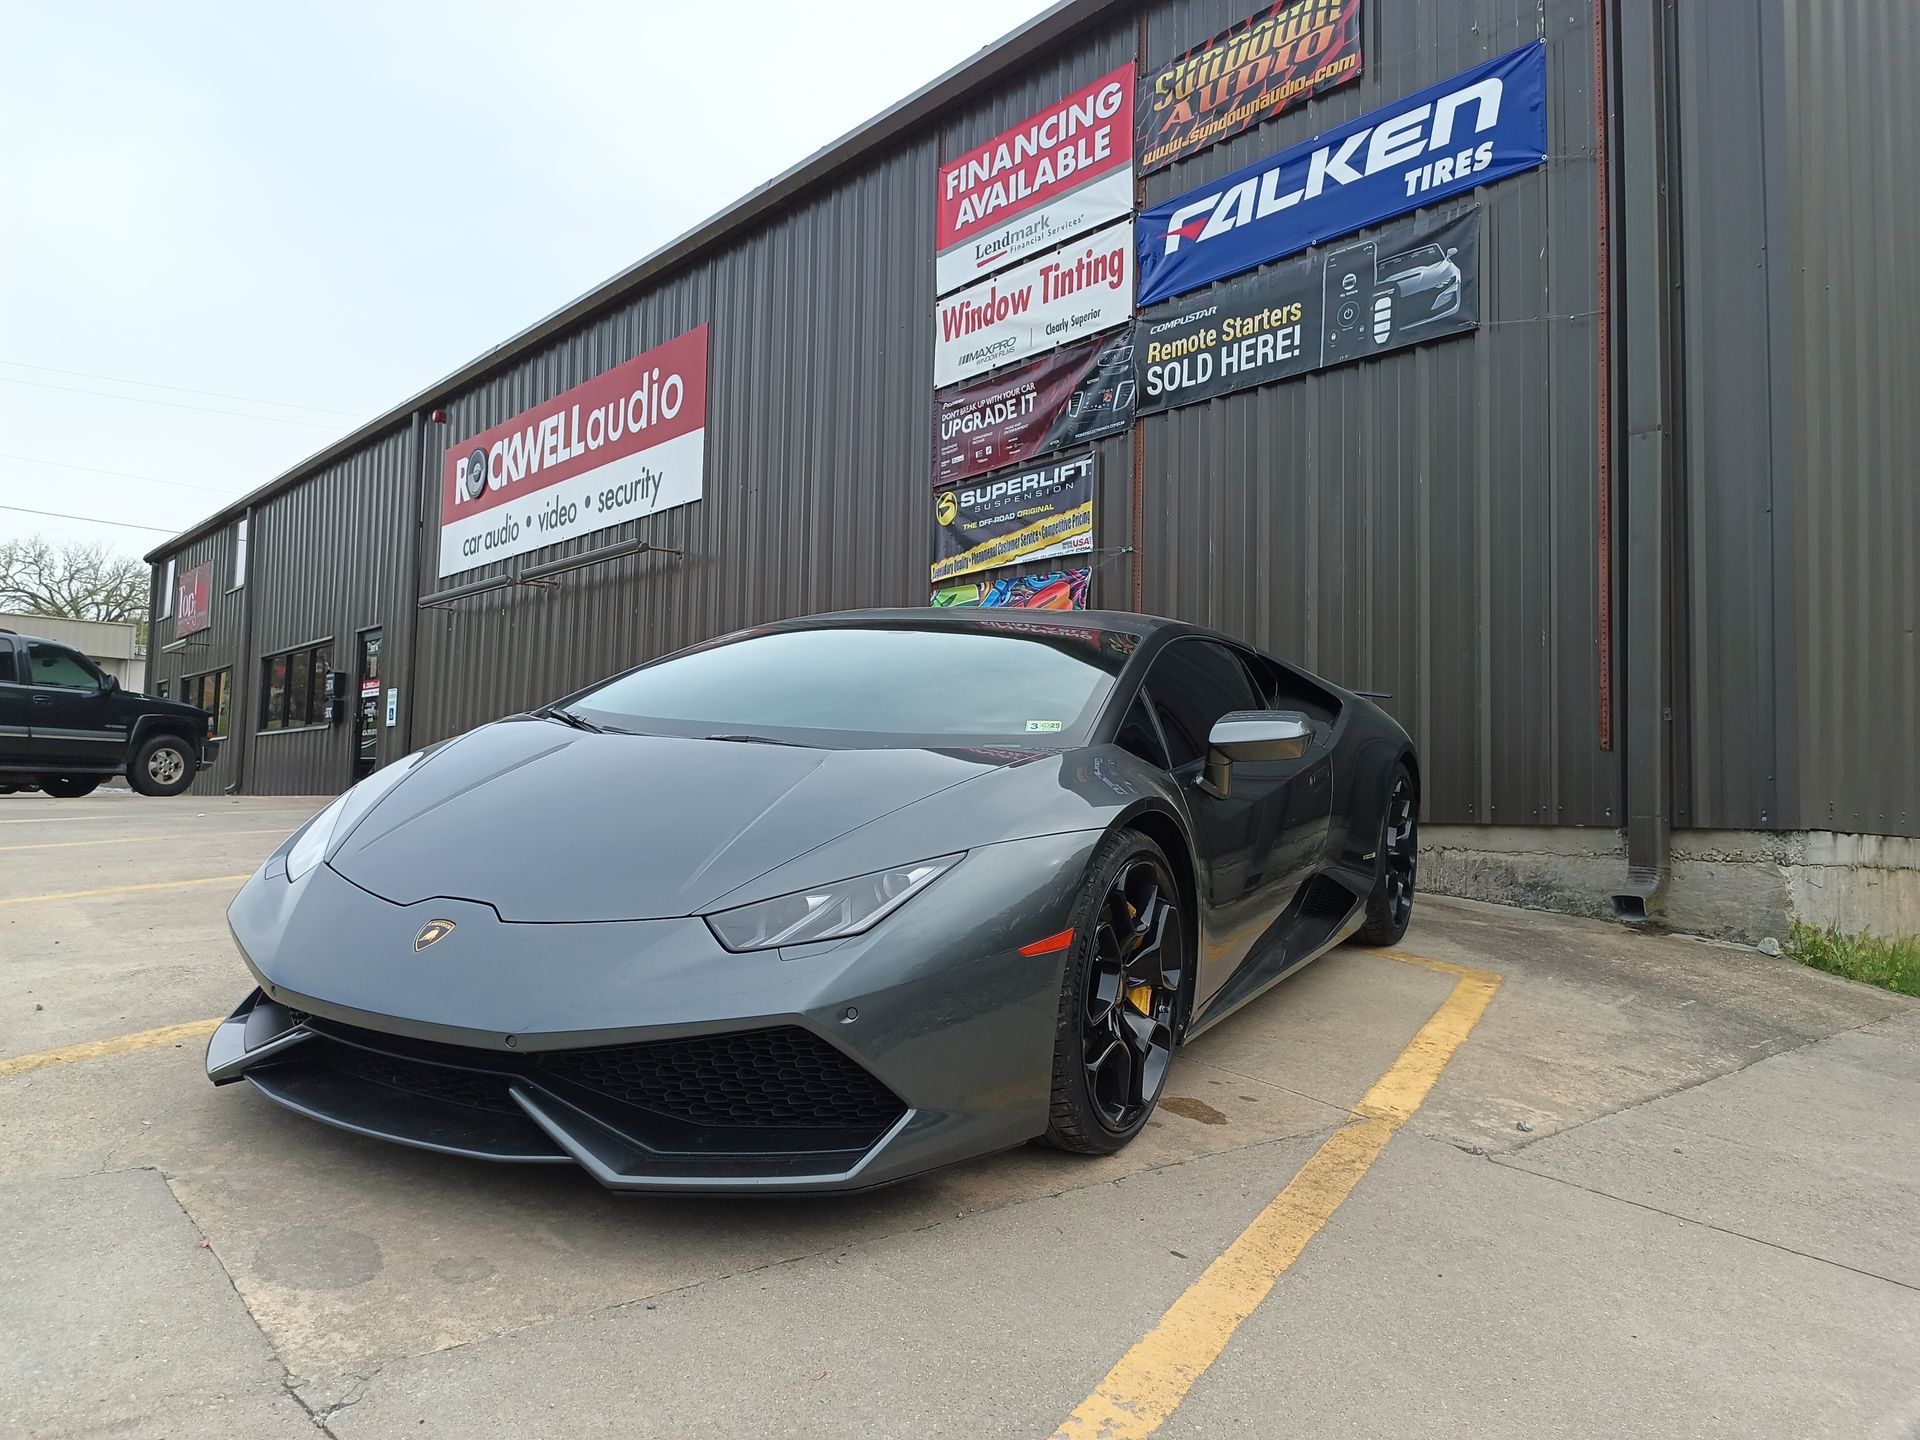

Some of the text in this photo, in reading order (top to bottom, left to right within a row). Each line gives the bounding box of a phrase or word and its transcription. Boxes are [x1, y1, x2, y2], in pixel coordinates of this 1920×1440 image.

[1159, 24, 1336, 134] AUDIO
[1143, 54, 1356, 166] www.sundownaudio.com
[946, 82, 1123, 200] FINANCING
[954, 124, 1112, 231] AVAILABLE
[1160, 77, 1503, 256] FALKEN
[1404, 141, 1494, 198] TIRES
[975, 215, 1050, 260] Lendmark
[1009, 233, 1045, 253] Financial
[942, 247, 1125, 343] Window Tinting
[1045, 308, 1102, 336] Clearly Superior
[1147, 302, 1303, 364] Remote Starters
[1150, 306, 1219, 335] COMPUSTAR
[967, 336, 1017, 362] MAXPRO
[1146, 325, 1301, 396] SOLD HERE!
[941, 391, 1038, 440] UPGRADE IT
[960, 403, 978, 416] BREAK
[977, 400, 987, 409] UP
[986, 393, 1002, 406] WITH
[1002, 387, 1021, 401] YOUR
[1021, 382, 1036, 395] CAR
[960, 459, 1093, 508] SUPERLIFT
[974, 482, 1075, 513] SUSPENSION
[463, 466, 664, 557] car audio video security
[962, 503, 1055, 531] THE OFF-ROAD ORIGINAL
[1020, 530, 1039, 547] Service
[1073, 537, 1090, 548] USA
